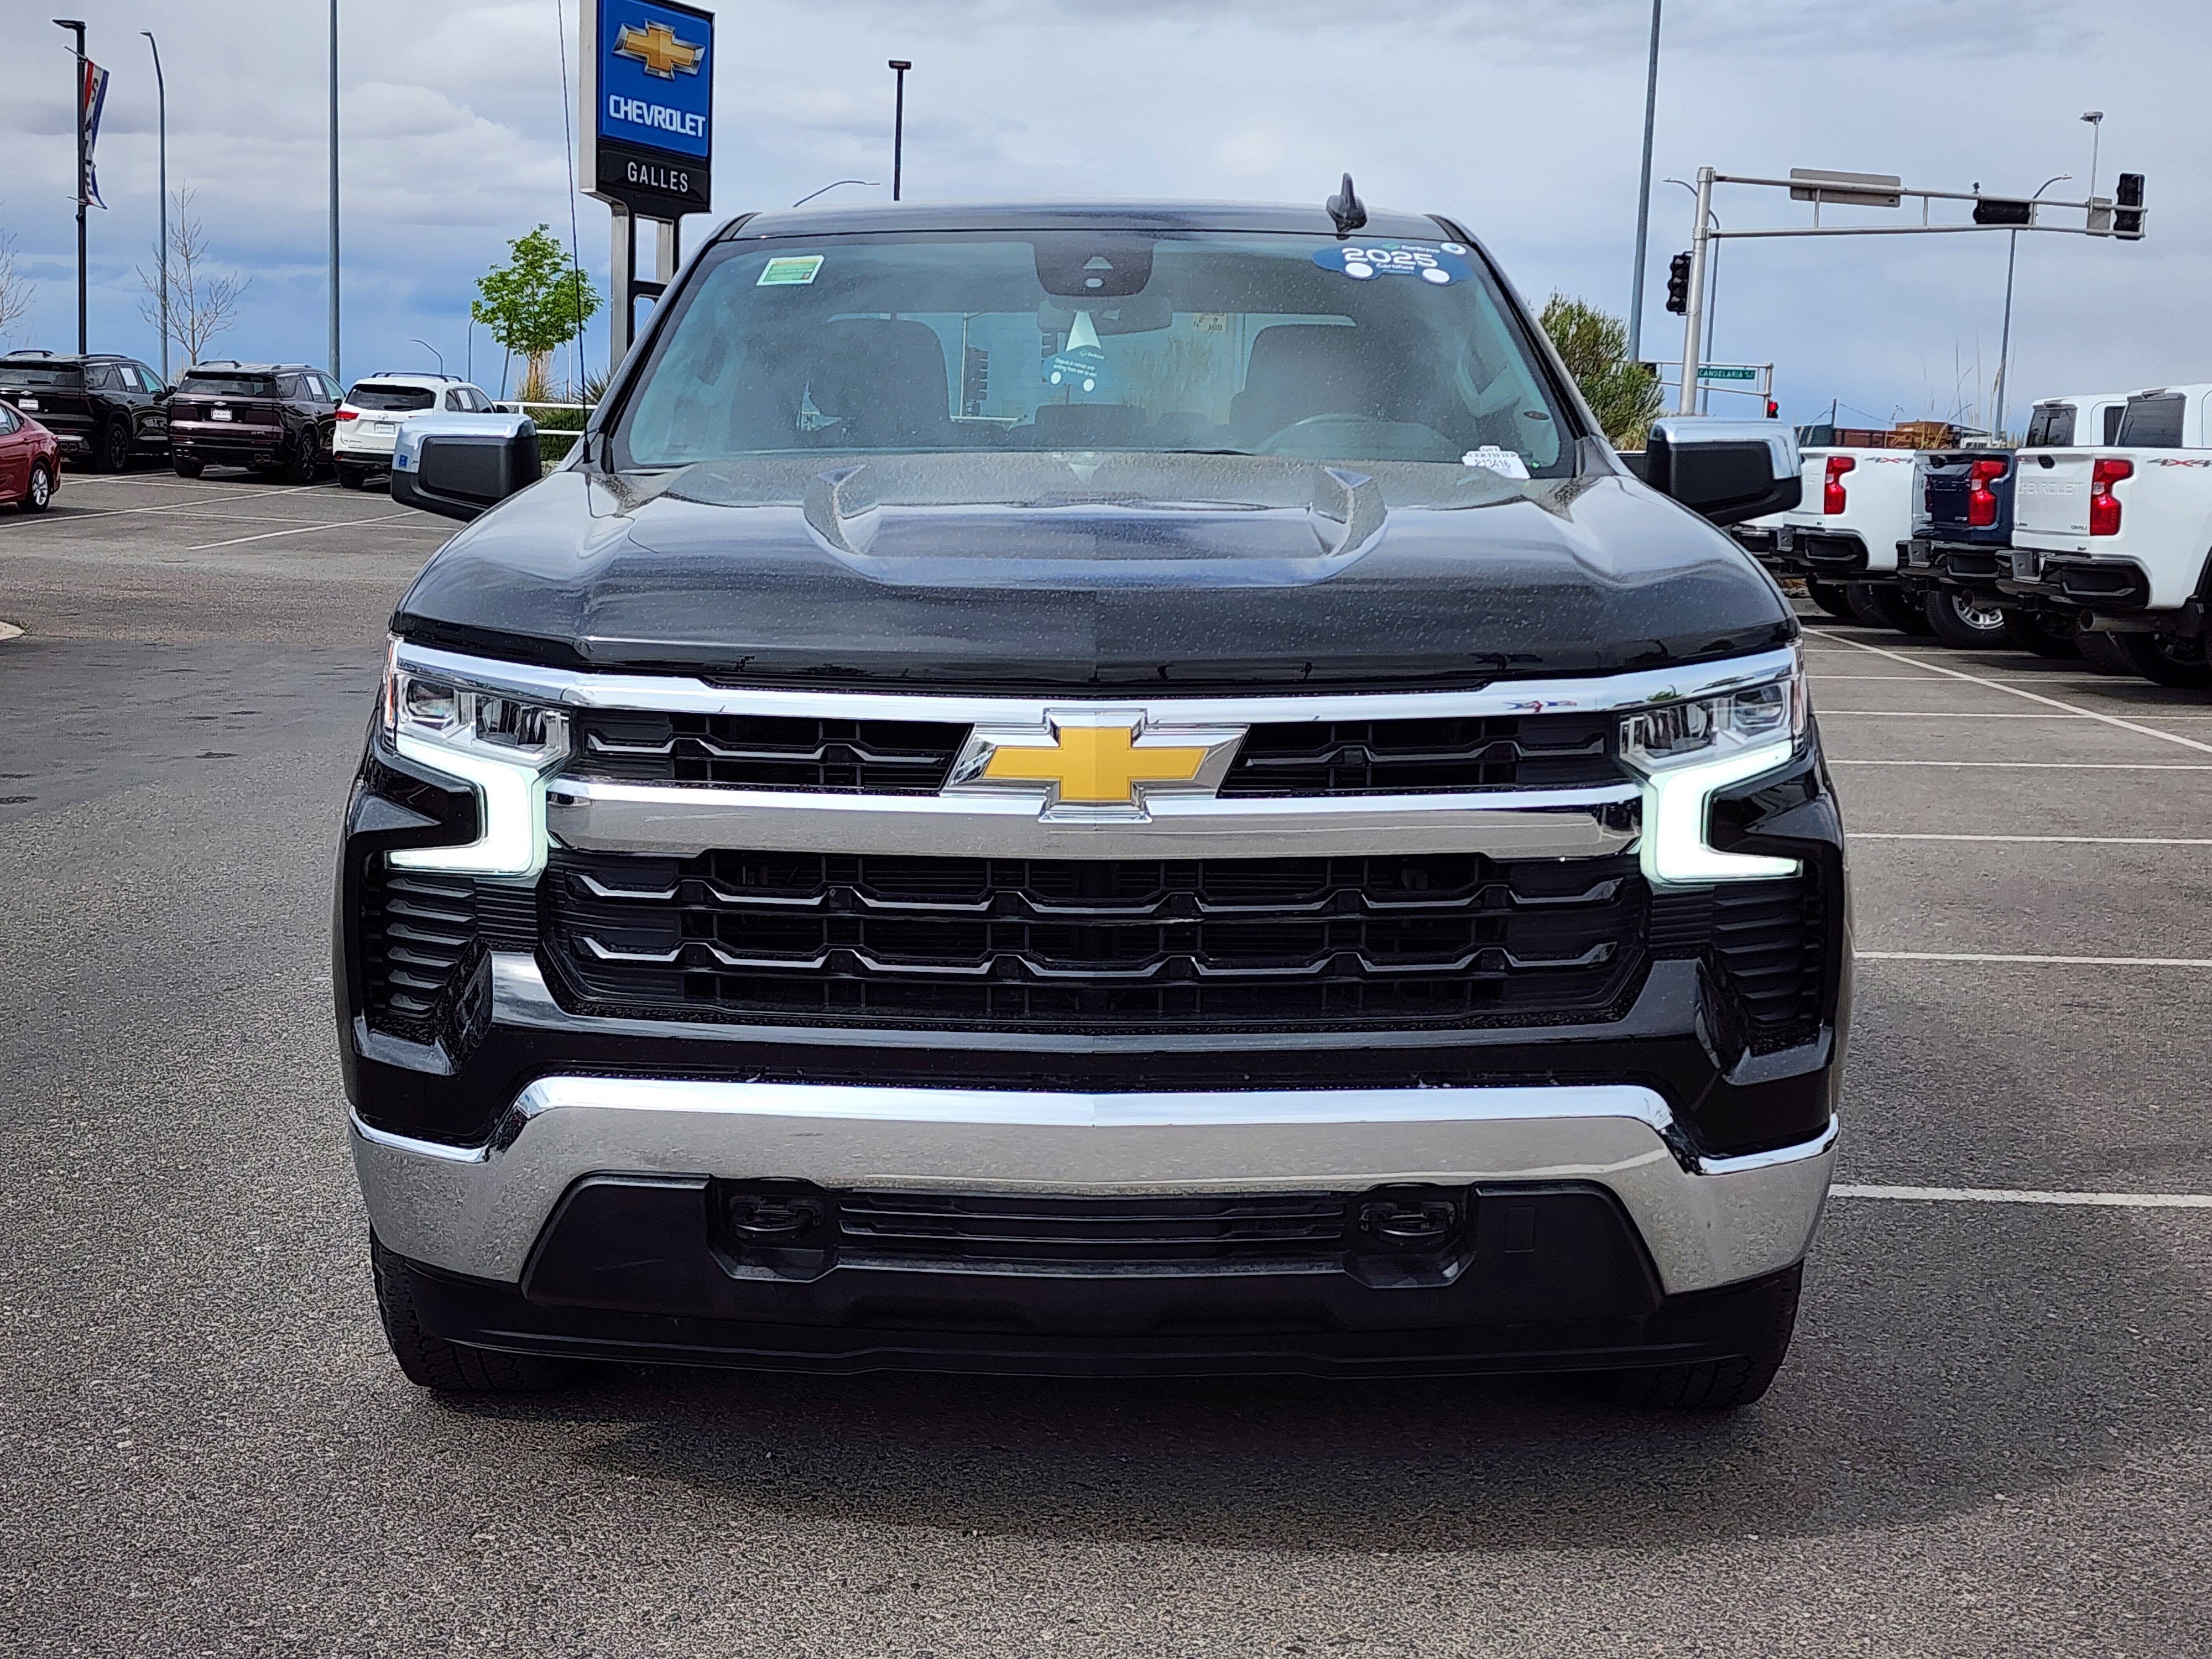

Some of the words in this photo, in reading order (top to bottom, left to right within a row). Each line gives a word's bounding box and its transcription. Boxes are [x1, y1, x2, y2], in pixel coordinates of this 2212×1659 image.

[609, 94, 706, 138] CHEVROLET
[627, 161, 688, 192] GALLES
[1342, 248, 1438, 267] 2025
